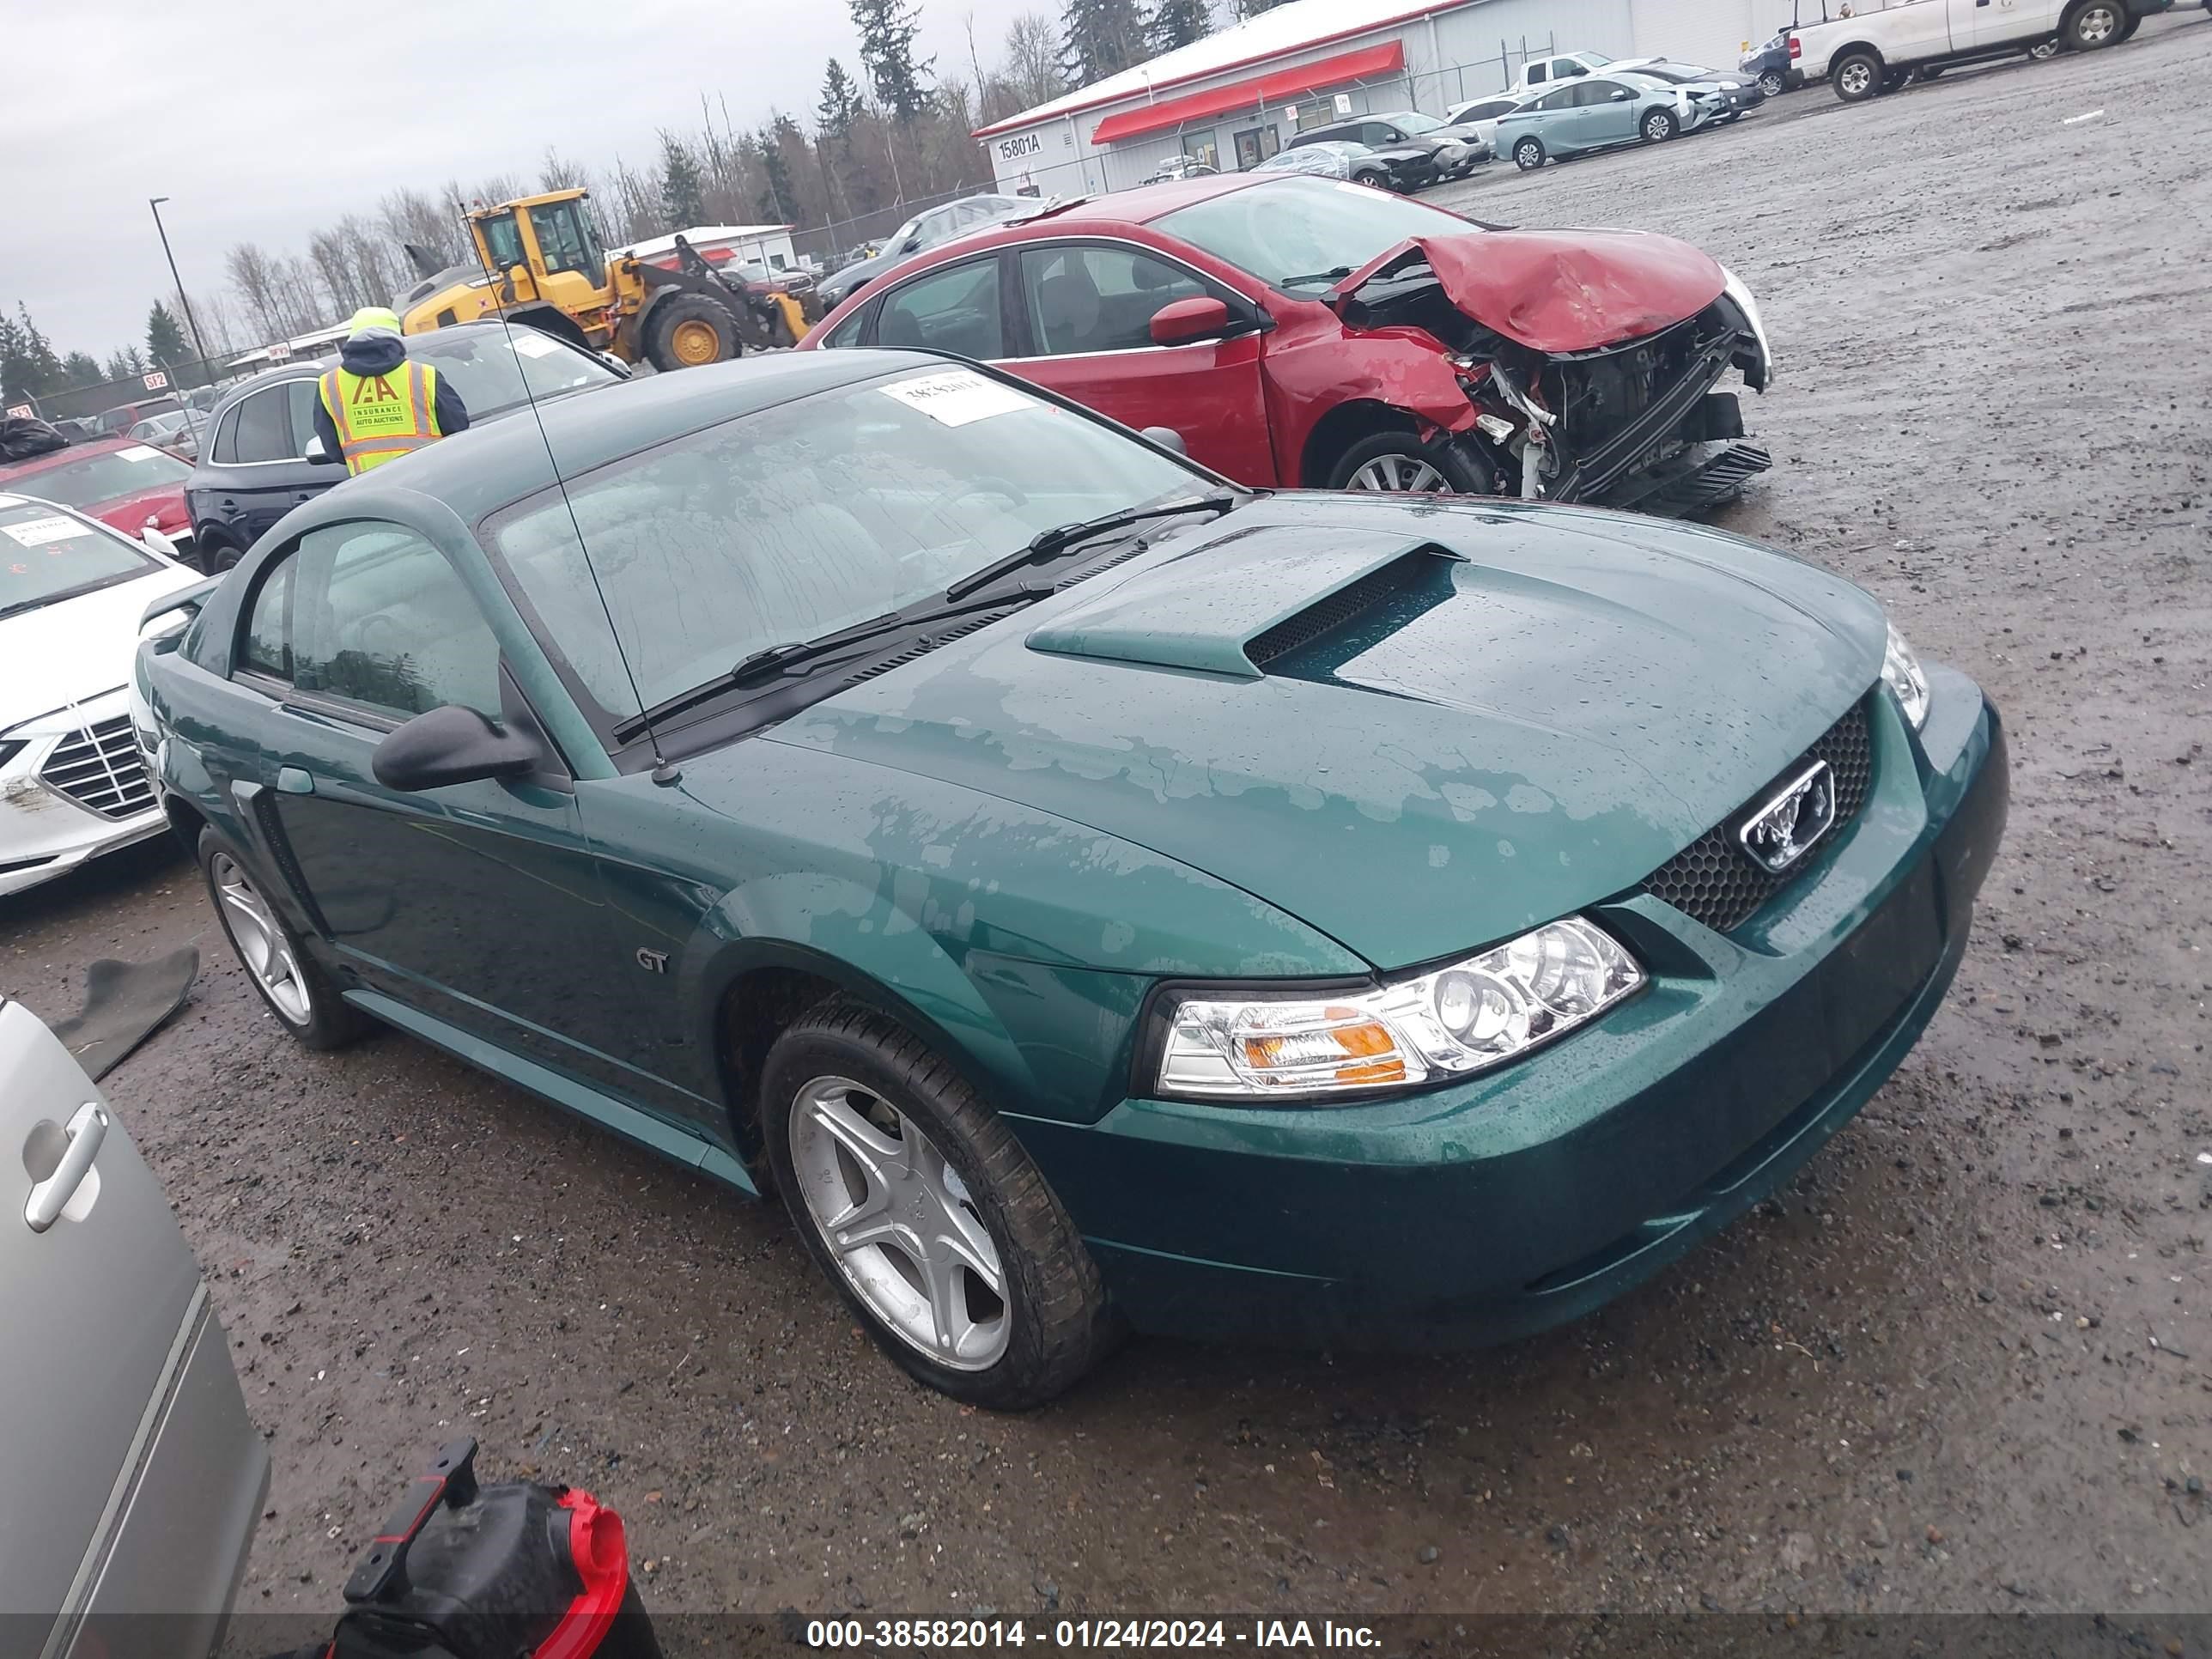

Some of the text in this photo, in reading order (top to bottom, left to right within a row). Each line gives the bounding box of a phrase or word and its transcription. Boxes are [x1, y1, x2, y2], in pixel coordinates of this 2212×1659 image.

[999, 134, 1040, 160] 15801A
[146, 375, 165, 388] SF2
[353, 405, 402, 416] INSURANCE
[374, 416, 404, 424] AUCTIONS
[636, 947, 668, 974] GT
